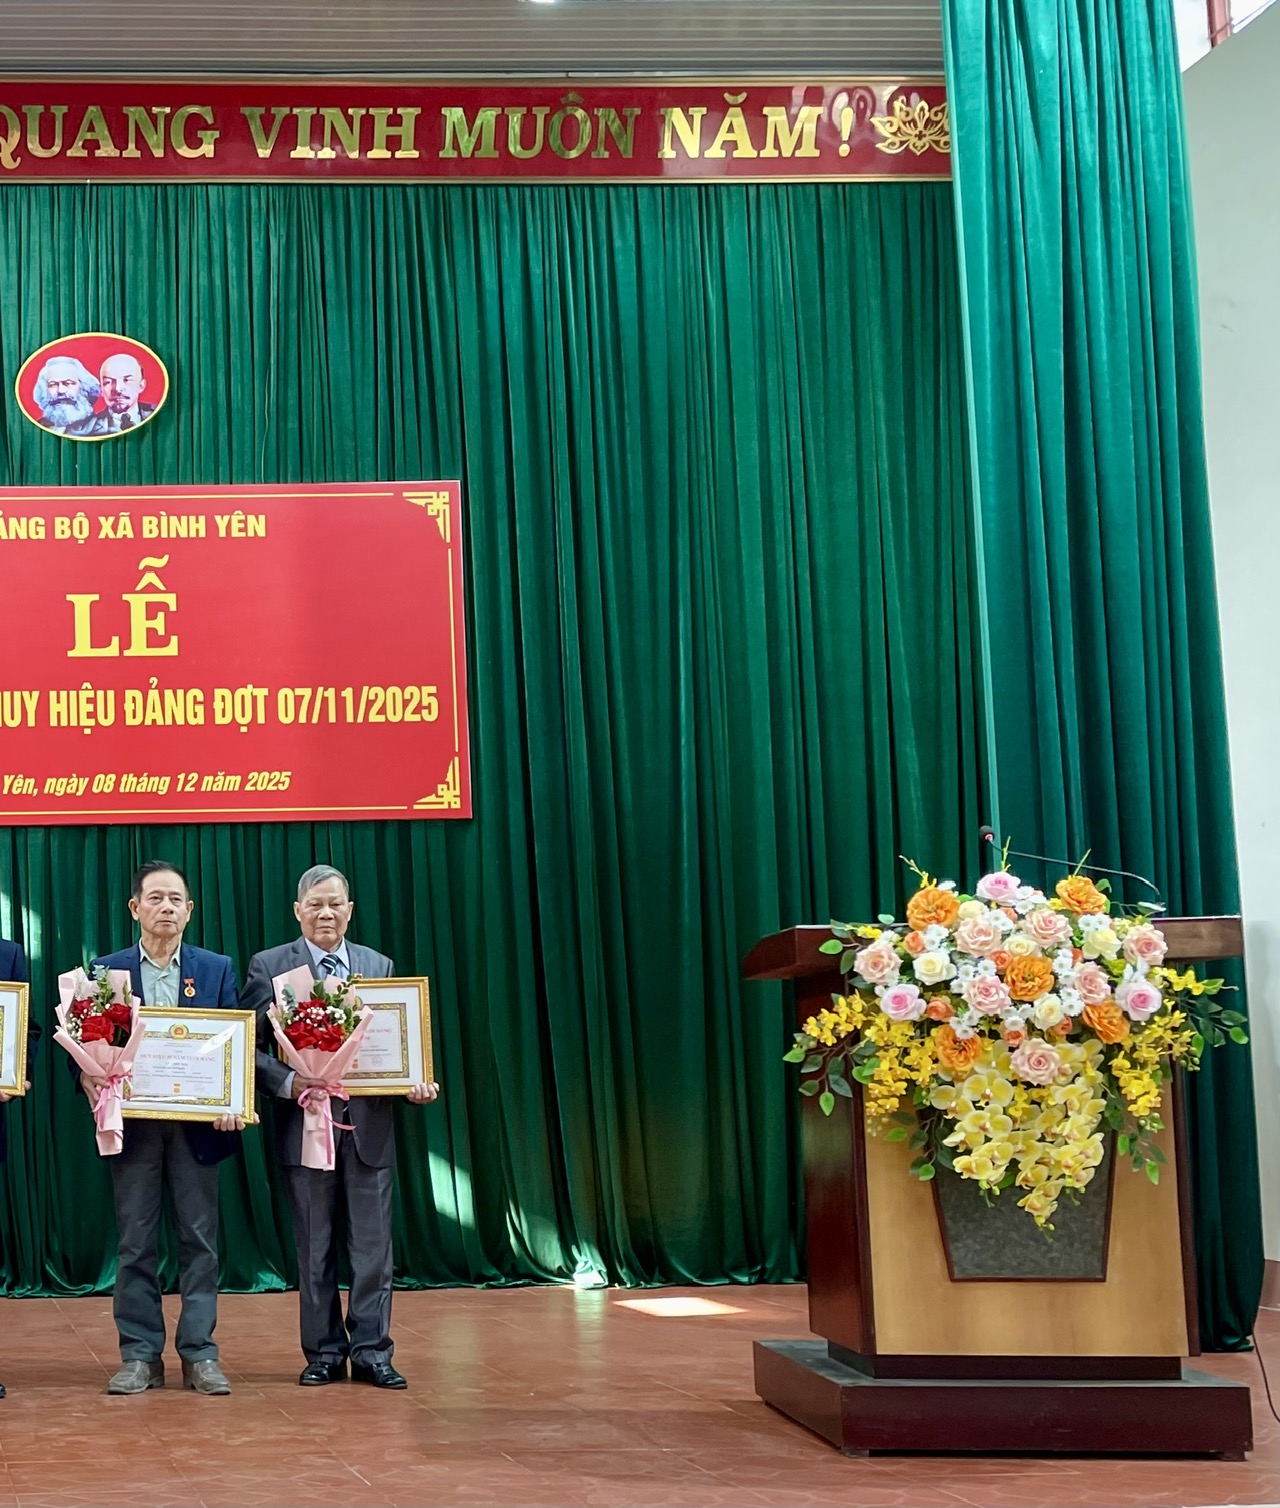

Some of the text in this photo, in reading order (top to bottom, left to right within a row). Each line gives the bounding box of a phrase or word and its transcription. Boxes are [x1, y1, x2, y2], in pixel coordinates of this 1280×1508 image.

[240, 105, 421, 159] VINH
[441, 92, 635, 159] MUÔN
[658, 92, 825, 159] NĂM
[54, 512, 90, 544] BỘ
[98, 512, 135, 540] XÃ
[142, 512, 207, 539] BÌNH
[215, 511, 267, 538] YÊN
[66, 554, 179, 658] LỄ
[48, 682, 116, 735] HIỆU
[123, 676, 205, 727] ĐẢNG
[212, 685, 270, 733] ĐỢT
[276, 685, 440, 725] 07/11/2025
[2, 774, 38, 796] Yên,
[43, 773, 89, 797] ngày
[91, 773, 116, 796] 08
[119, 773, 171, 796] tháng
[176, 771, 199, 793] 12
[201, 771, 242, 793] năm
[244, 770, 292, 792] 2025
